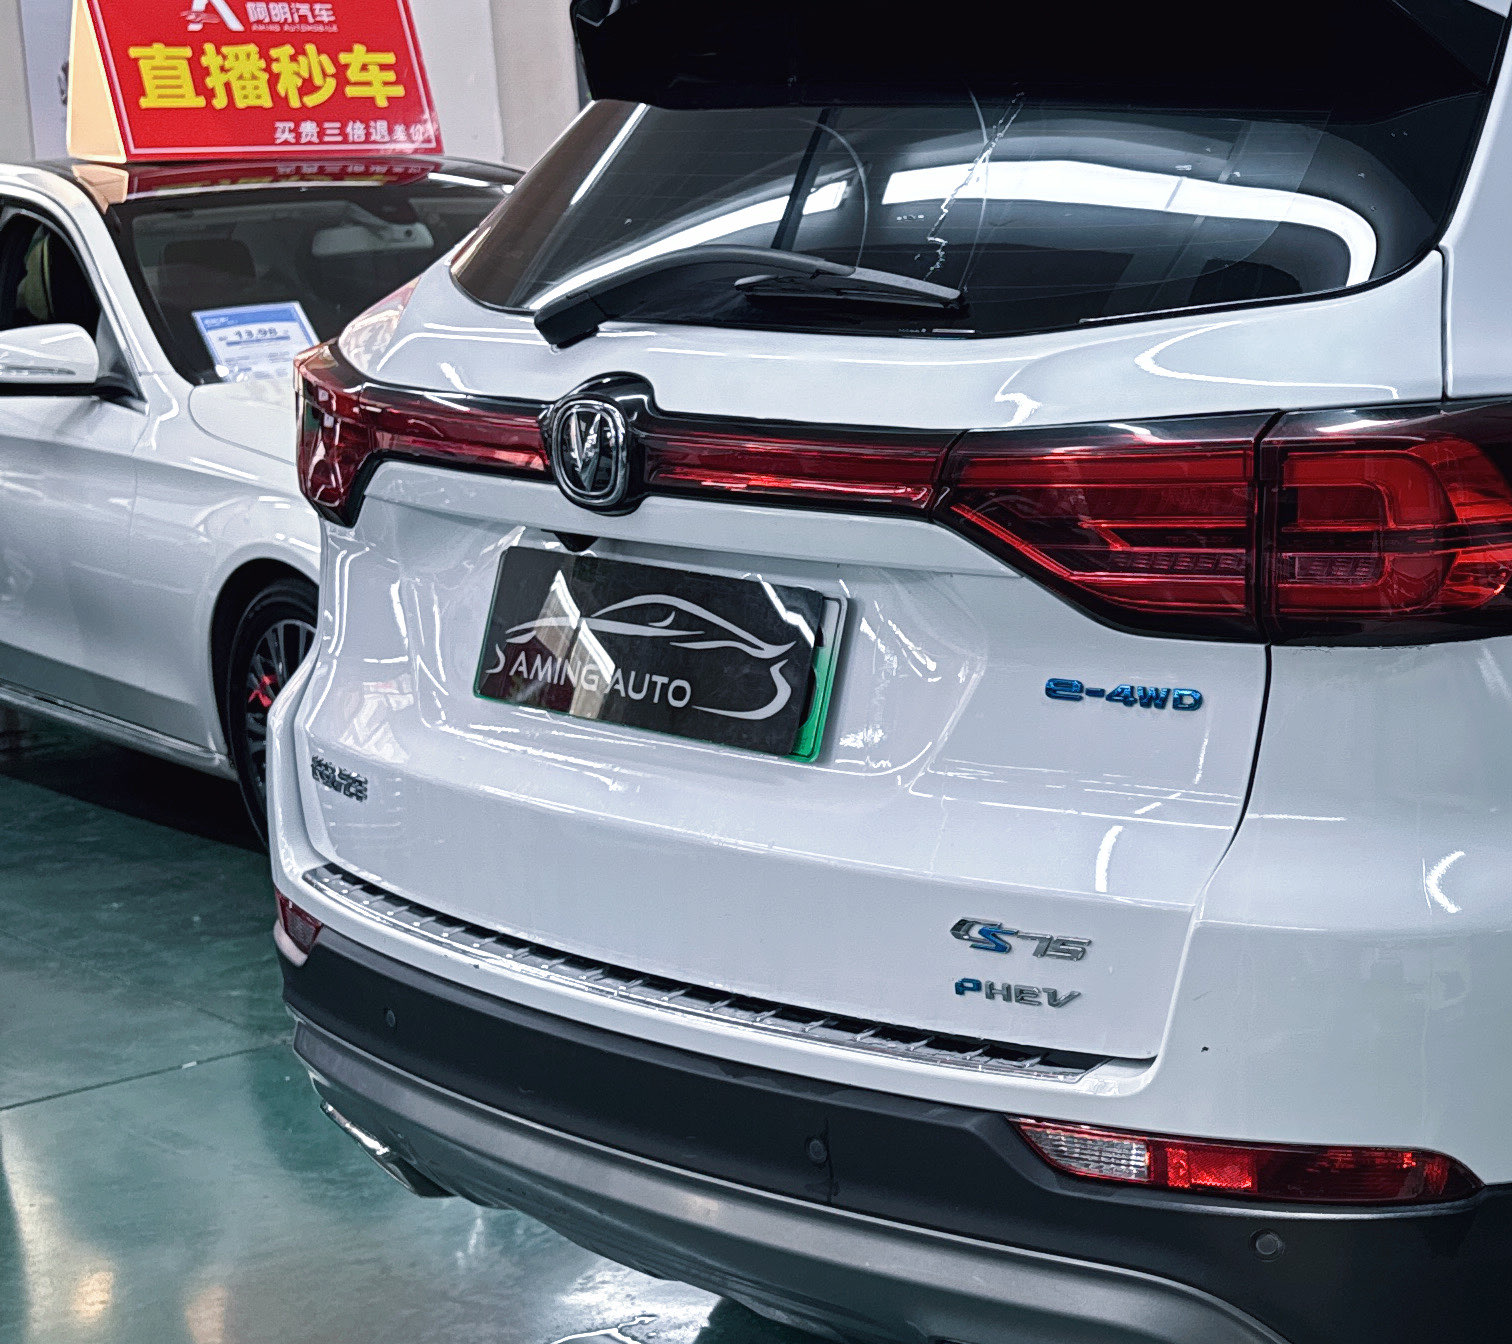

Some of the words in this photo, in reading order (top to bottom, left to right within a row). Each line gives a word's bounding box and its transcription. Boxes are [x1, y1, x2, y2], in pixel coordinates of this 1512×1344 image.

[245, 1, 336, 23] 阿明汽车
[128, 42, 405, 110] 直播秒车
[509, 650, 601, 692] AMING
[609, 668, 692, 707] AUTO
[954, 977, 1082, 1009] PHEV
